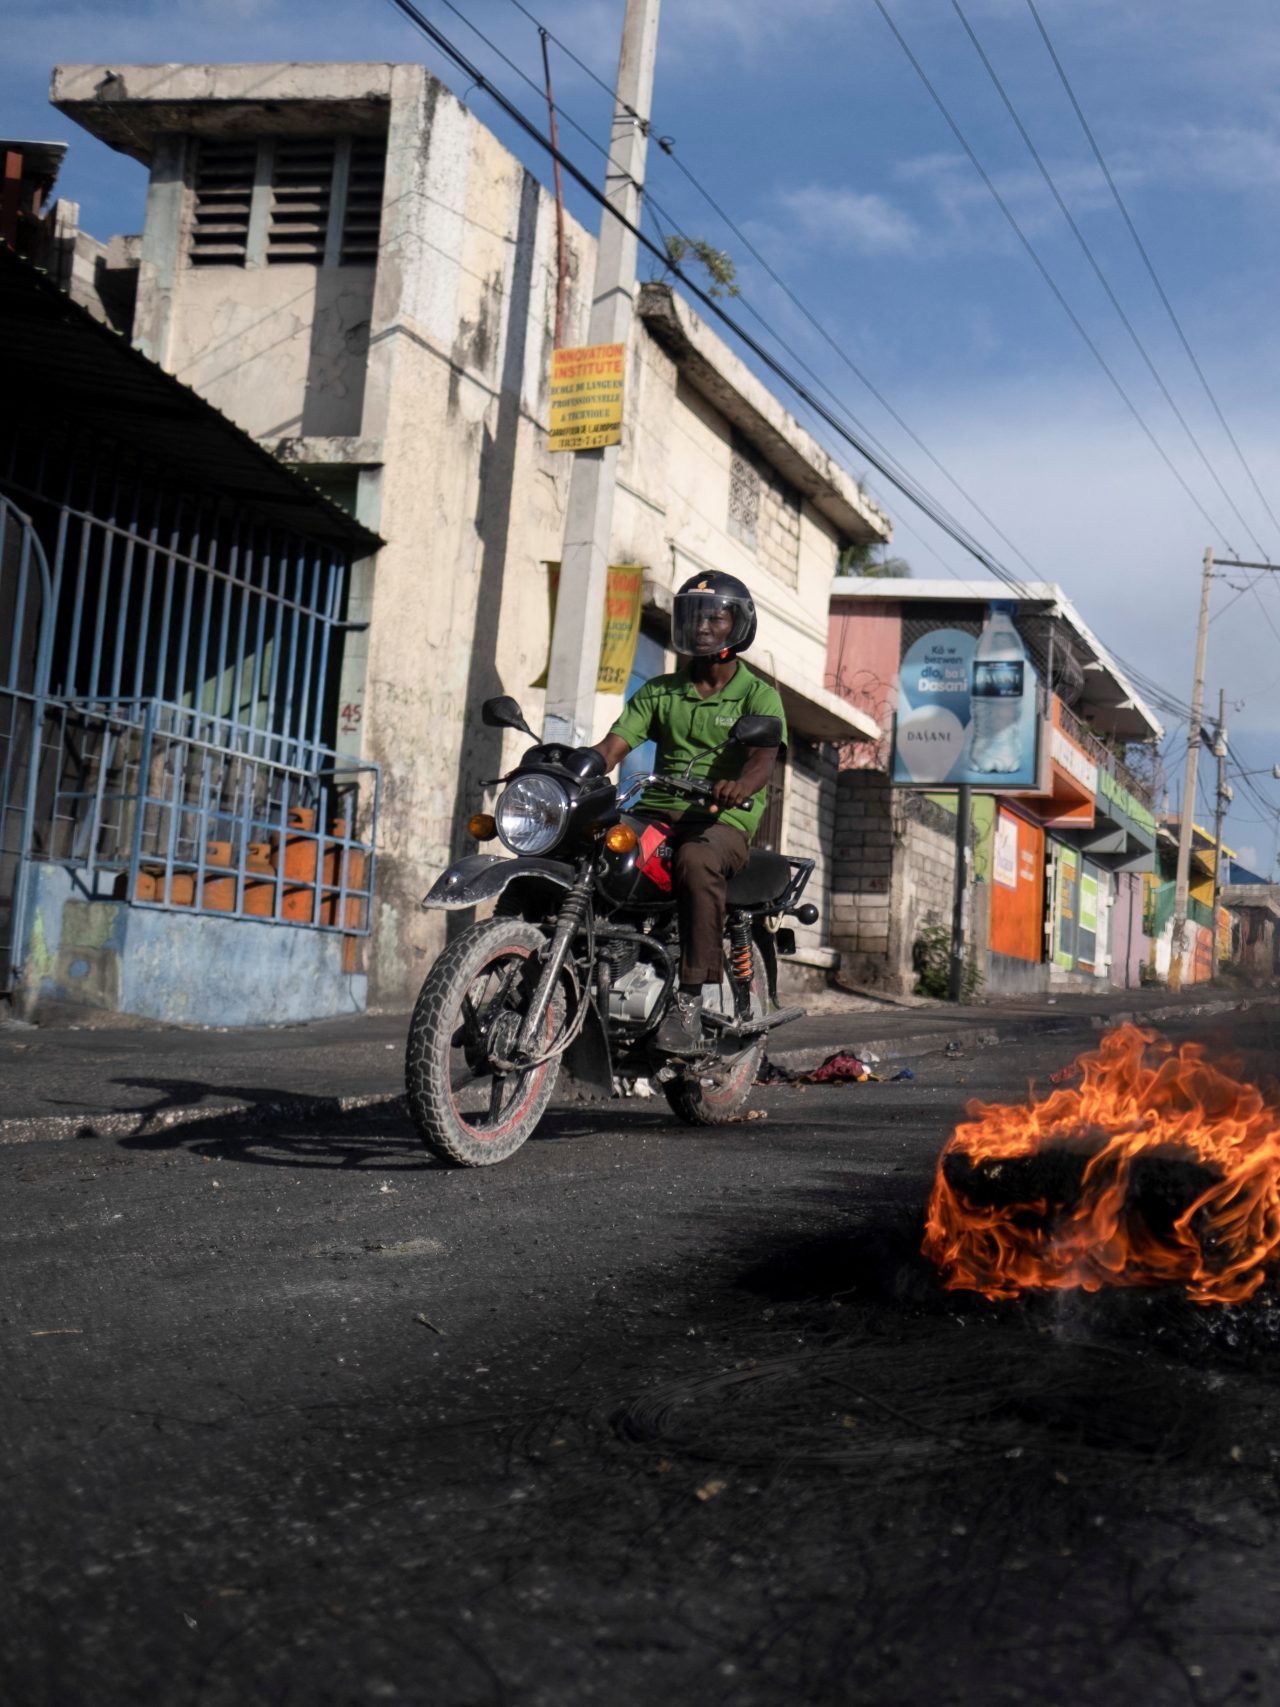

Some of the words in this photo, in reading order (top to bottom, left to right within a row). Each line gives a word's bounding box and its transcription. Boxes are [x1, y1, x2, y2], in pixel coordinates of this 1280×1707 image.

[554, 345, 623, 363] INNOVATION
[554, 361, 621, 379] INSTITUTE
[924, 655, 962, 664] bezwen
[921, 667, 943, 679] dlo,
[919, 679, 968, 691] Dasani
[341, 703, 362, 723] 45
[907, 730, 950, 743] DASANI
